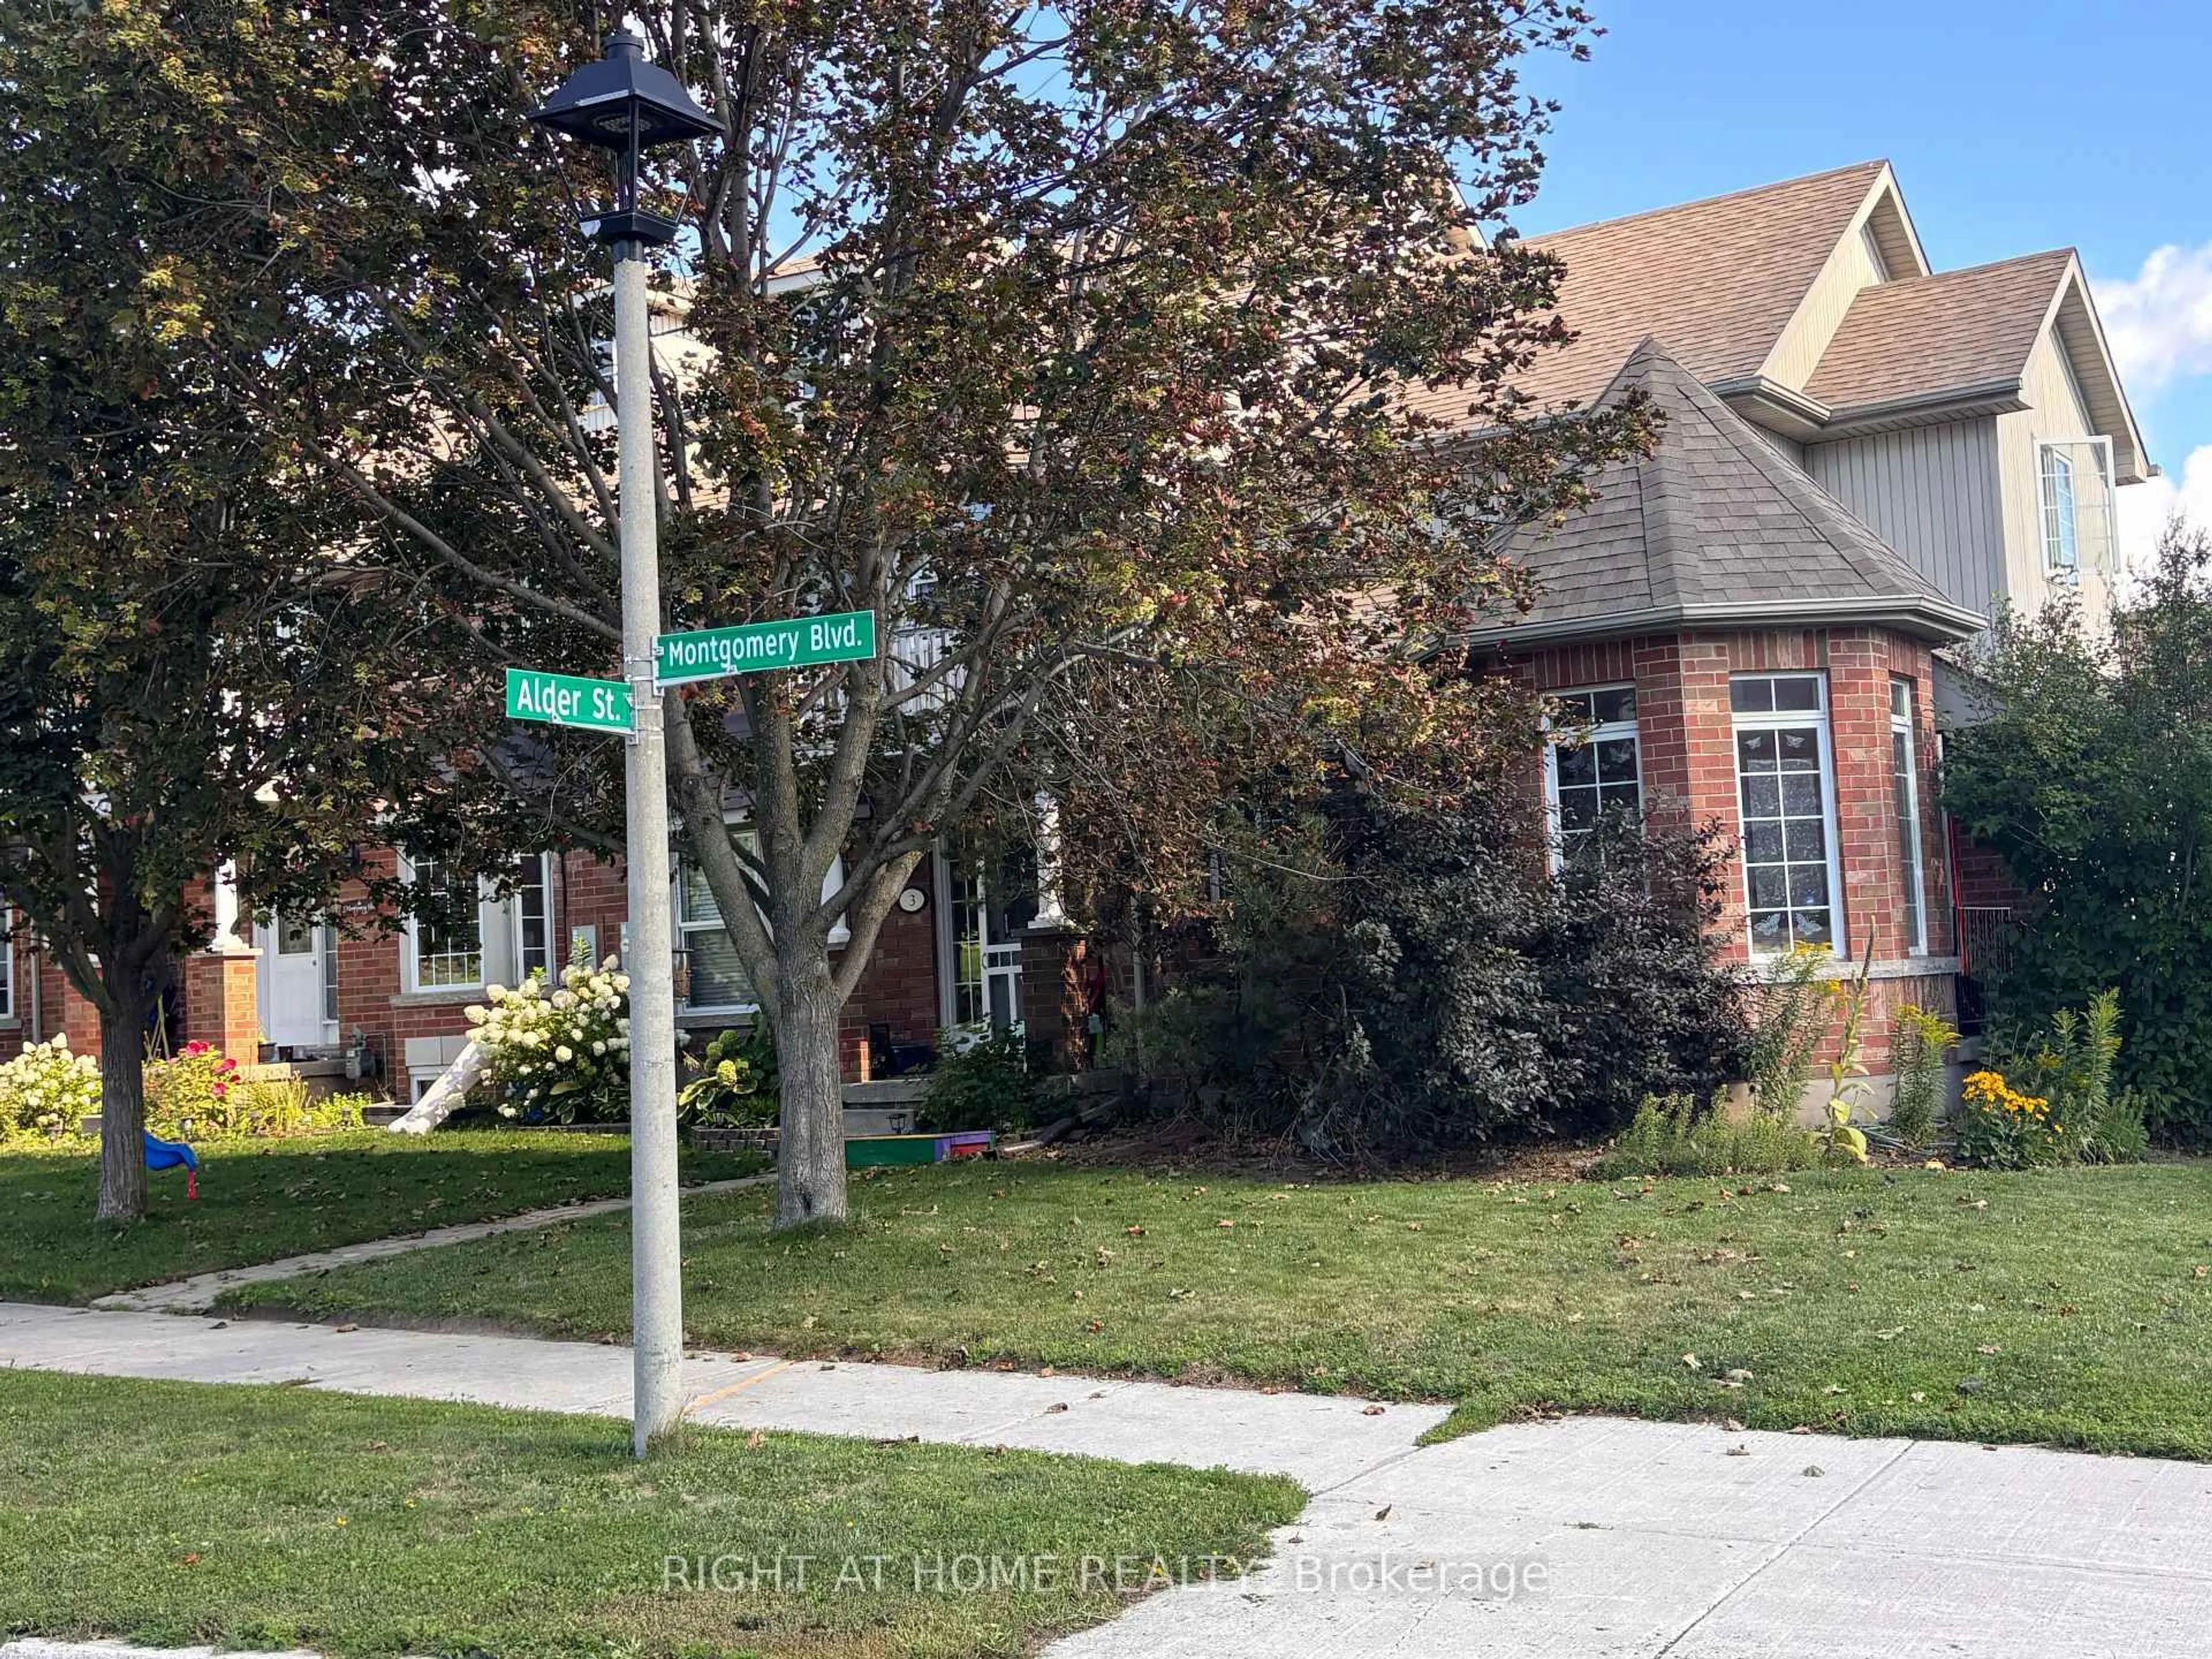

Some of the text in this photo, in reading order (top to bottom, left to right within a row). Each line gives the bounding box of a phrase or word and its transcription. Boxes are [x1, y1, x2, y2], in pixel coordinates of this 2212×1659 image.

[669, 619, 862, 668] Montgomery Blvd.
[517, 677, 621, 721] Alder St.
